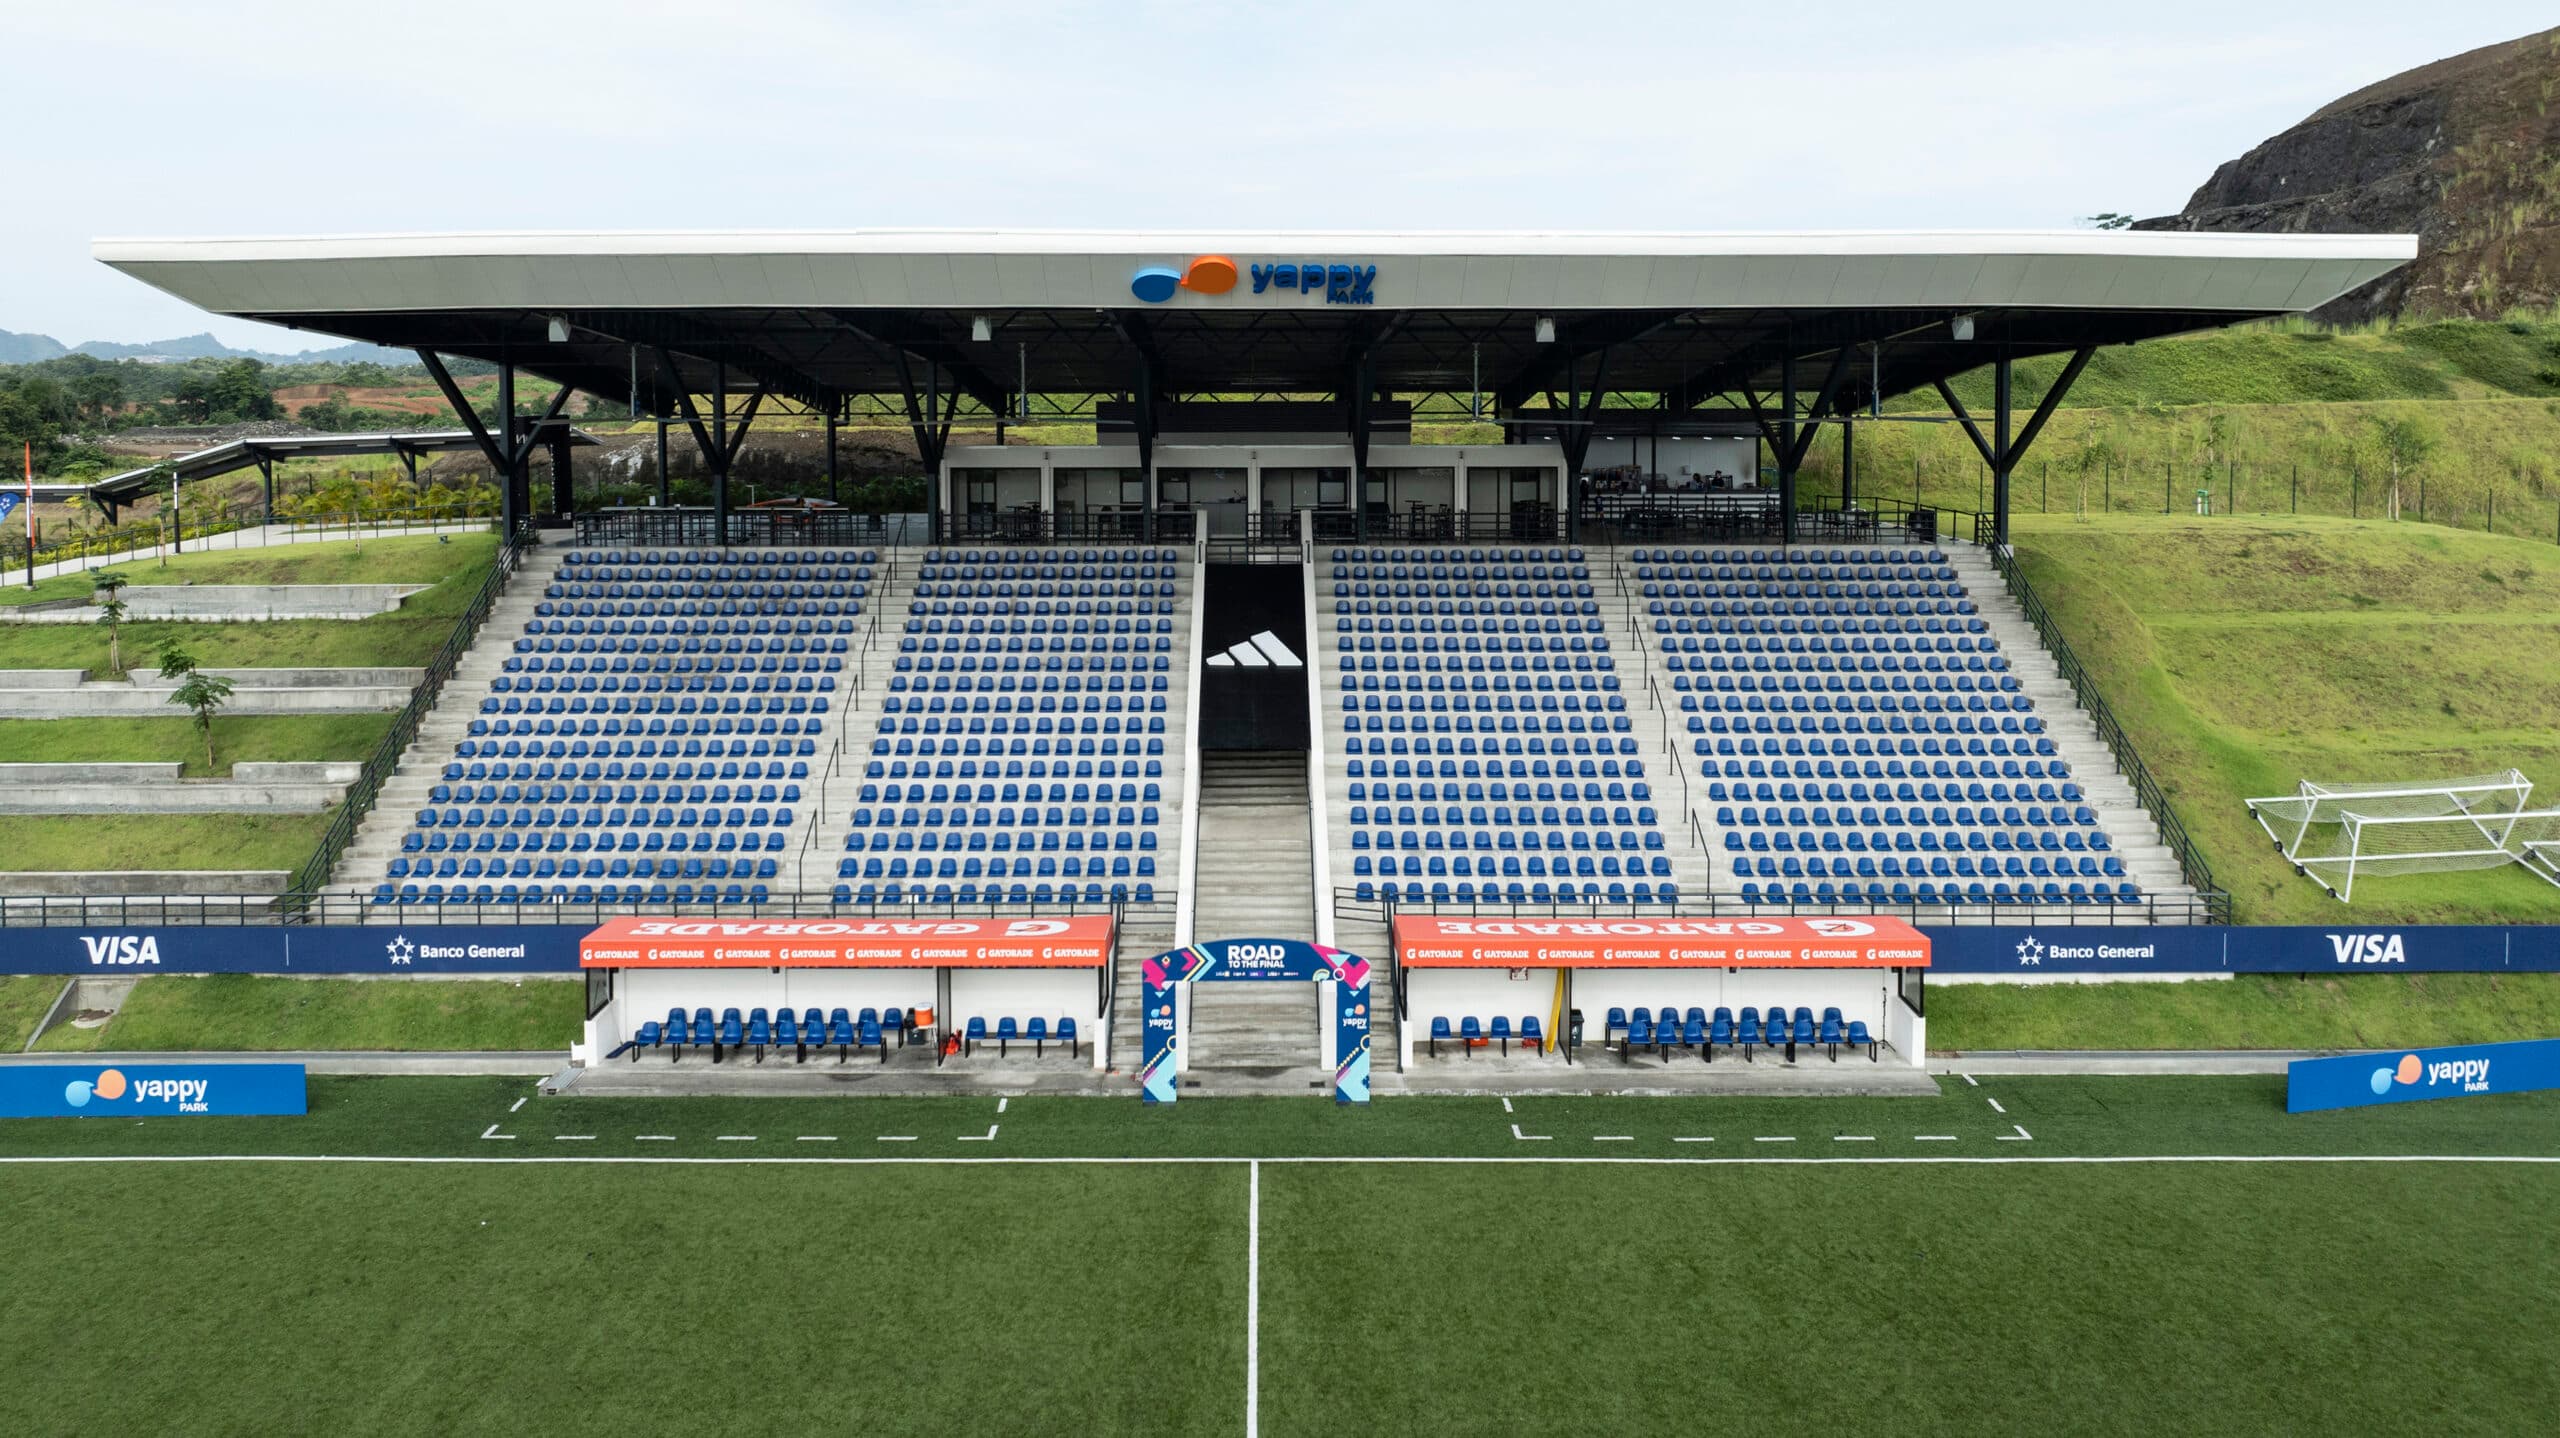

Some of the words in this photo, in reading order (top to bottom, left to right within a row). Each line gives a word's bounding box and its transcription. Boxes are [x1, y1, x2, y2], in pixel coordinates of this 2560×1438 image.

[1251, 263, 1376, 294] yappy
[629, 921, 980, 936] GATORADE
[1437, 921, 1785, 936] GATORADE
[80, 936, 160, 964] VISA
[421, 944, 465, 958] Banco
[468, 944, 524, 958] General
[923, 949, 967, 958] GATORADE
[989, 949, 1033, 957] GATORADE
[1055, 949, 1099, 957] GATORADE
[1227, 945, 1286, 961] ROAD
[2050, 945, 2094, 959] Banco
[2098, 944, 2154, 959] General
[2326, 935, 2404, 963] VISA
[595, 950, 639, 959] GATORADE
[660, 950, 704, 958] GATORADE
[726, 950, 770, 958] GATORADE
[792, 950, 836, 958] GATORADE
[857, 950, 902, 958] GATORADE
[1419, 950, 1462, 958] GATORADE
[1484, 950, 1528, 958] GATORADE
[1550, 950, 1594, 958] GATORADE
[1616, 950, 1660, 958] GATORADE
[1681, 950, 1726, 958] GATORADE
[1747, 950, 1791, 958] GATORADE
[1813, 950, 1857, 958] GATORADE
[1879, 950, 1923, 958] GATORADE
[1229, 960, 1241, 968] TO
[1242, 960, 1258, 968] THE
[1259, 960, 1285, 968] FINAL
[1149, 1018, 1173, 1028] yappy
[1343, 1017, 1367, 1027] yappy
[2428, 1059, 2490, 1086] yappy
[134, 1079, 208, 1103] yappy
[2464, 1081, 2489, 1092] PARK
[179, 1102, 209, 1112] PARK
